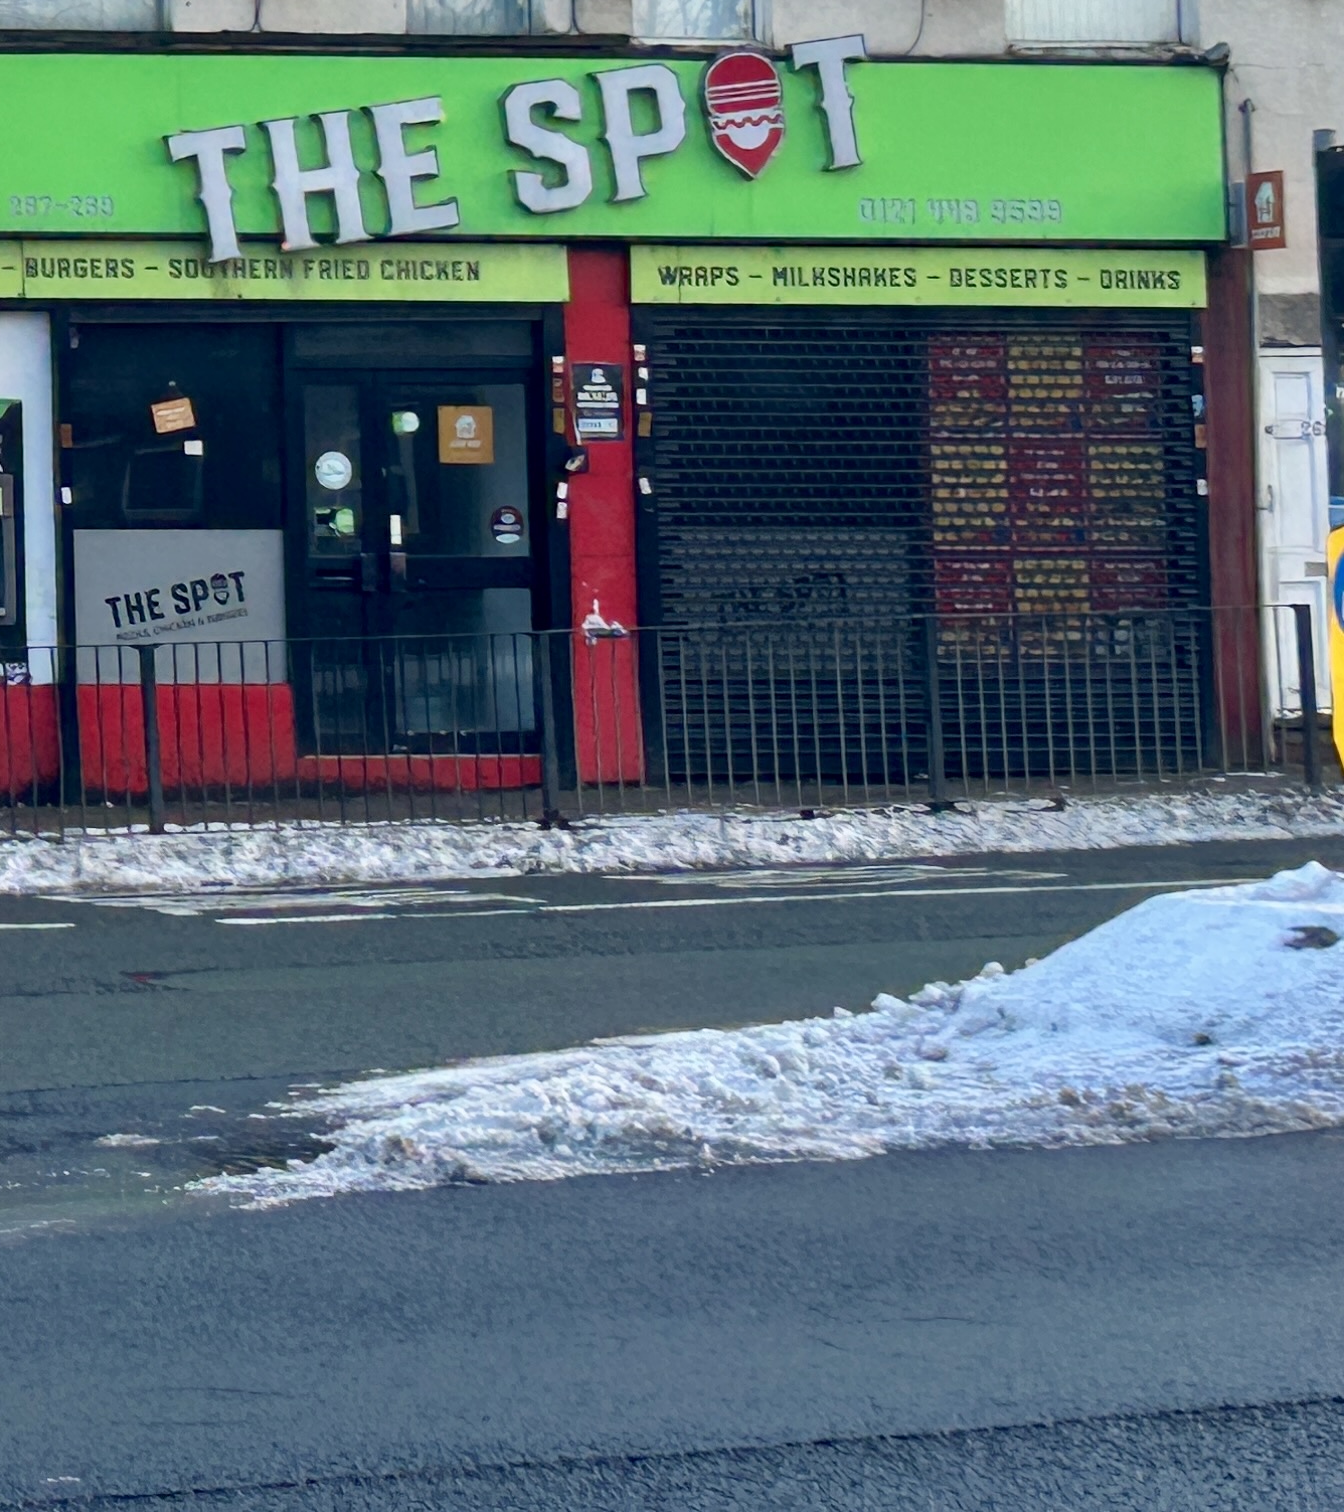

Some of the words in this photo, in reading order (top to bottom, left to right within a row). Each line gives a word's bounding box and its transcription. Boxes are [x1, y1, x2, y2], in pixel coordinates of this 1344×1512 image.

[164, 95, 461, 264] THE
[25, 257, 135, 280] BURGERS
[303, 259, 370, 281] FRIED
[380, 260, 481, 282] CHICKEN
[658, 266, 740, 286] WRAPS
[771, 267, 917, 288] MILKSHAKES
[949, 268, 1069, 289] DESSERTS
[1099, 269, 1181, 290] DRINKS
[104, 587, 166, 629] THE
